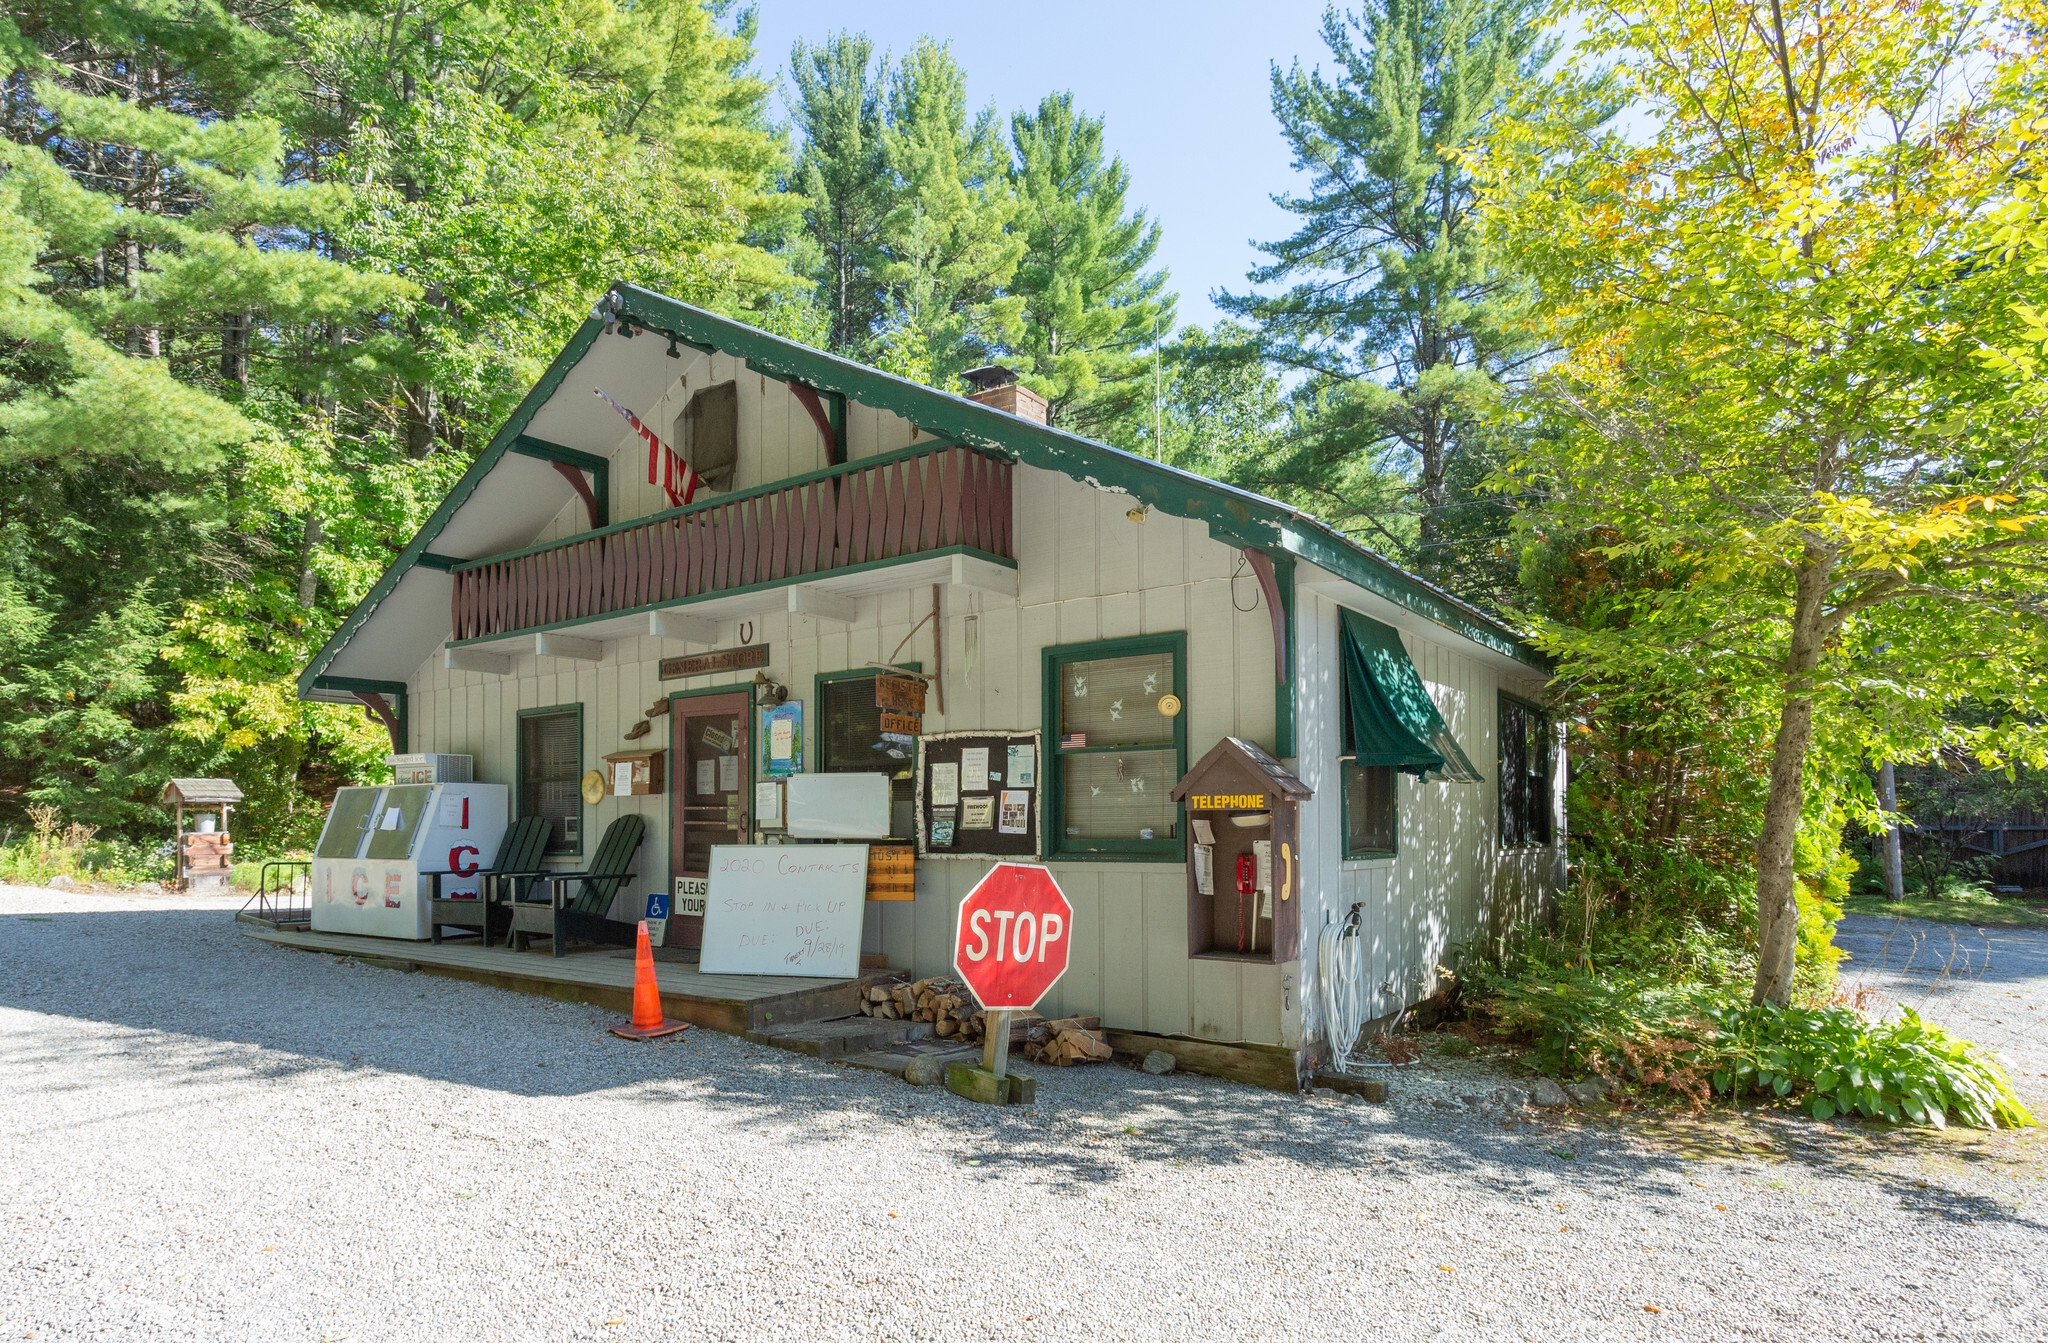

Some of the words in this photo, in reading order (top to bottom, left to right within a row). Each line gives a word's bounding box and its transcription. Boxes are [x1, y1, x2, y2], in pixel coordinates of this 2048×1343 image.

[662, 657, 719, 676] GENERAL
[720, 647, 764, 667] STORE
[879, 677, 925, 696] REGISTER
[884, 717, 919, 732] OFFICE
[705, 727, 725, 744] Closed
[411, 769, 432, 784] ICE
[1192, 795, 1264, 809] TELEPHONE
[719, 858, 765, 874] 2020
[326, 867, 401, 909] ICE
[762, 902, 776, 913] IN
[796, 901, 821, 913] PICK
[827, 901, 846, 914] UP
[795, 920, 829, 938] DUE:
[965, 908, 1064, 963] STOP
[739, 933, 775, 948] DUE:
[803, 935, 846, 959] 9/28/19
